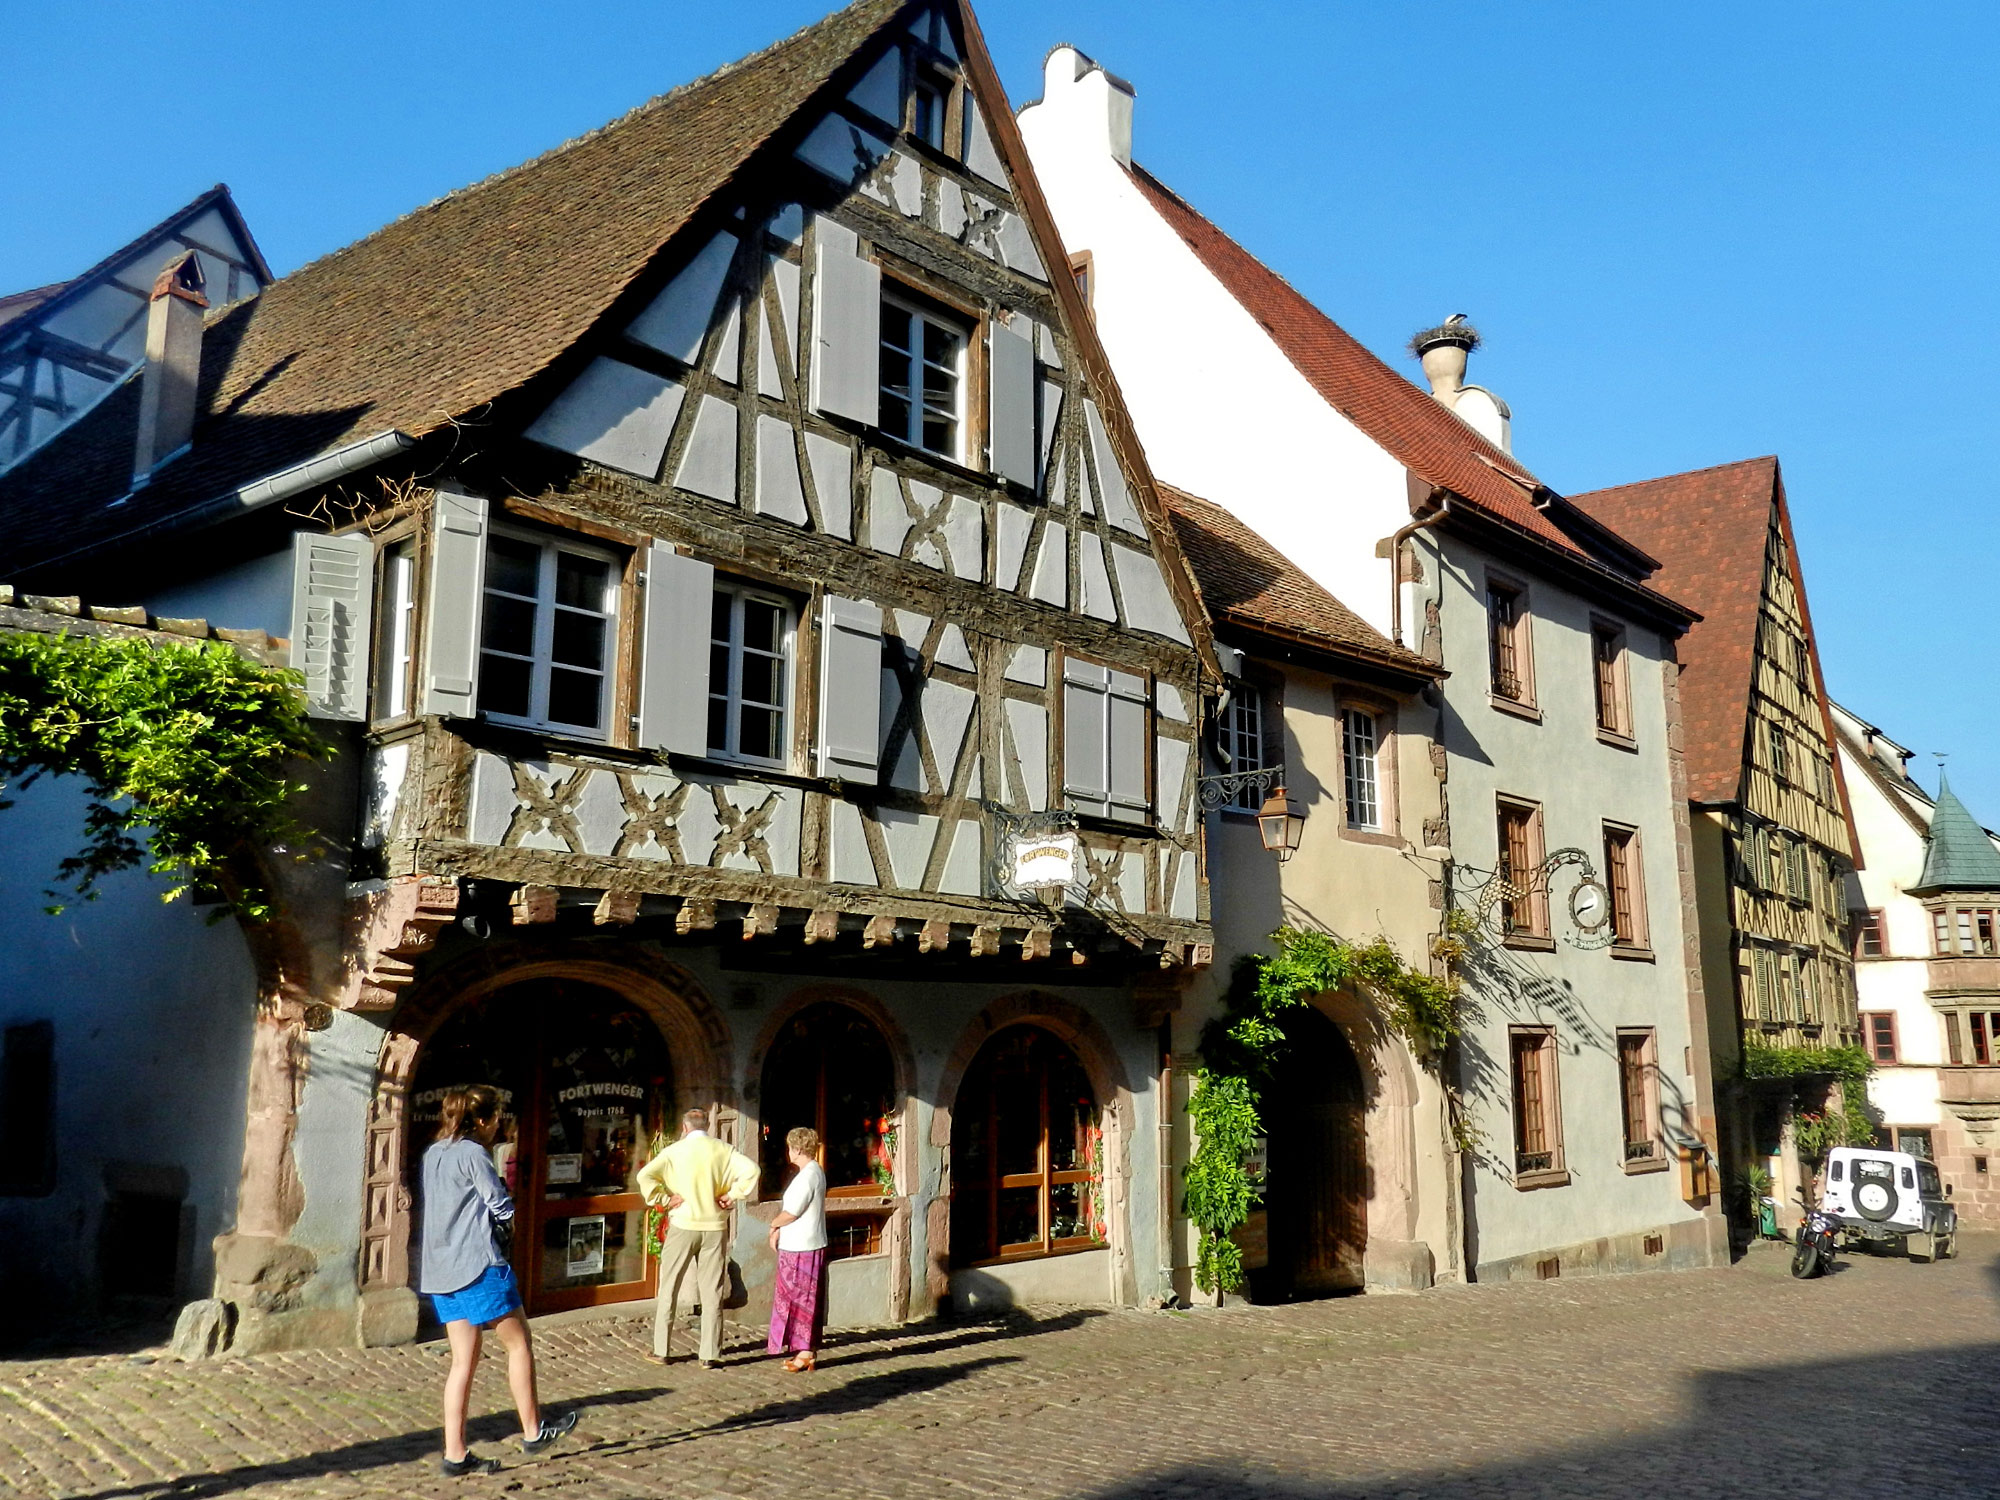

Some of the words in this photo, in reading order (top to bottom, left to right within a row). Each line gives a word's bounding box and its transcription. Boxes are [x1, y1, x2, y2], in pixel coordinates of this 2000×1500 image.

[1020, 846, 1069, 865] FORTWENGER
[558, 1083, 644, 1102] FORTWENGER
[577, 1106, 604, 1118] Depuis
[607, 1106, 625, 1115] 1768
